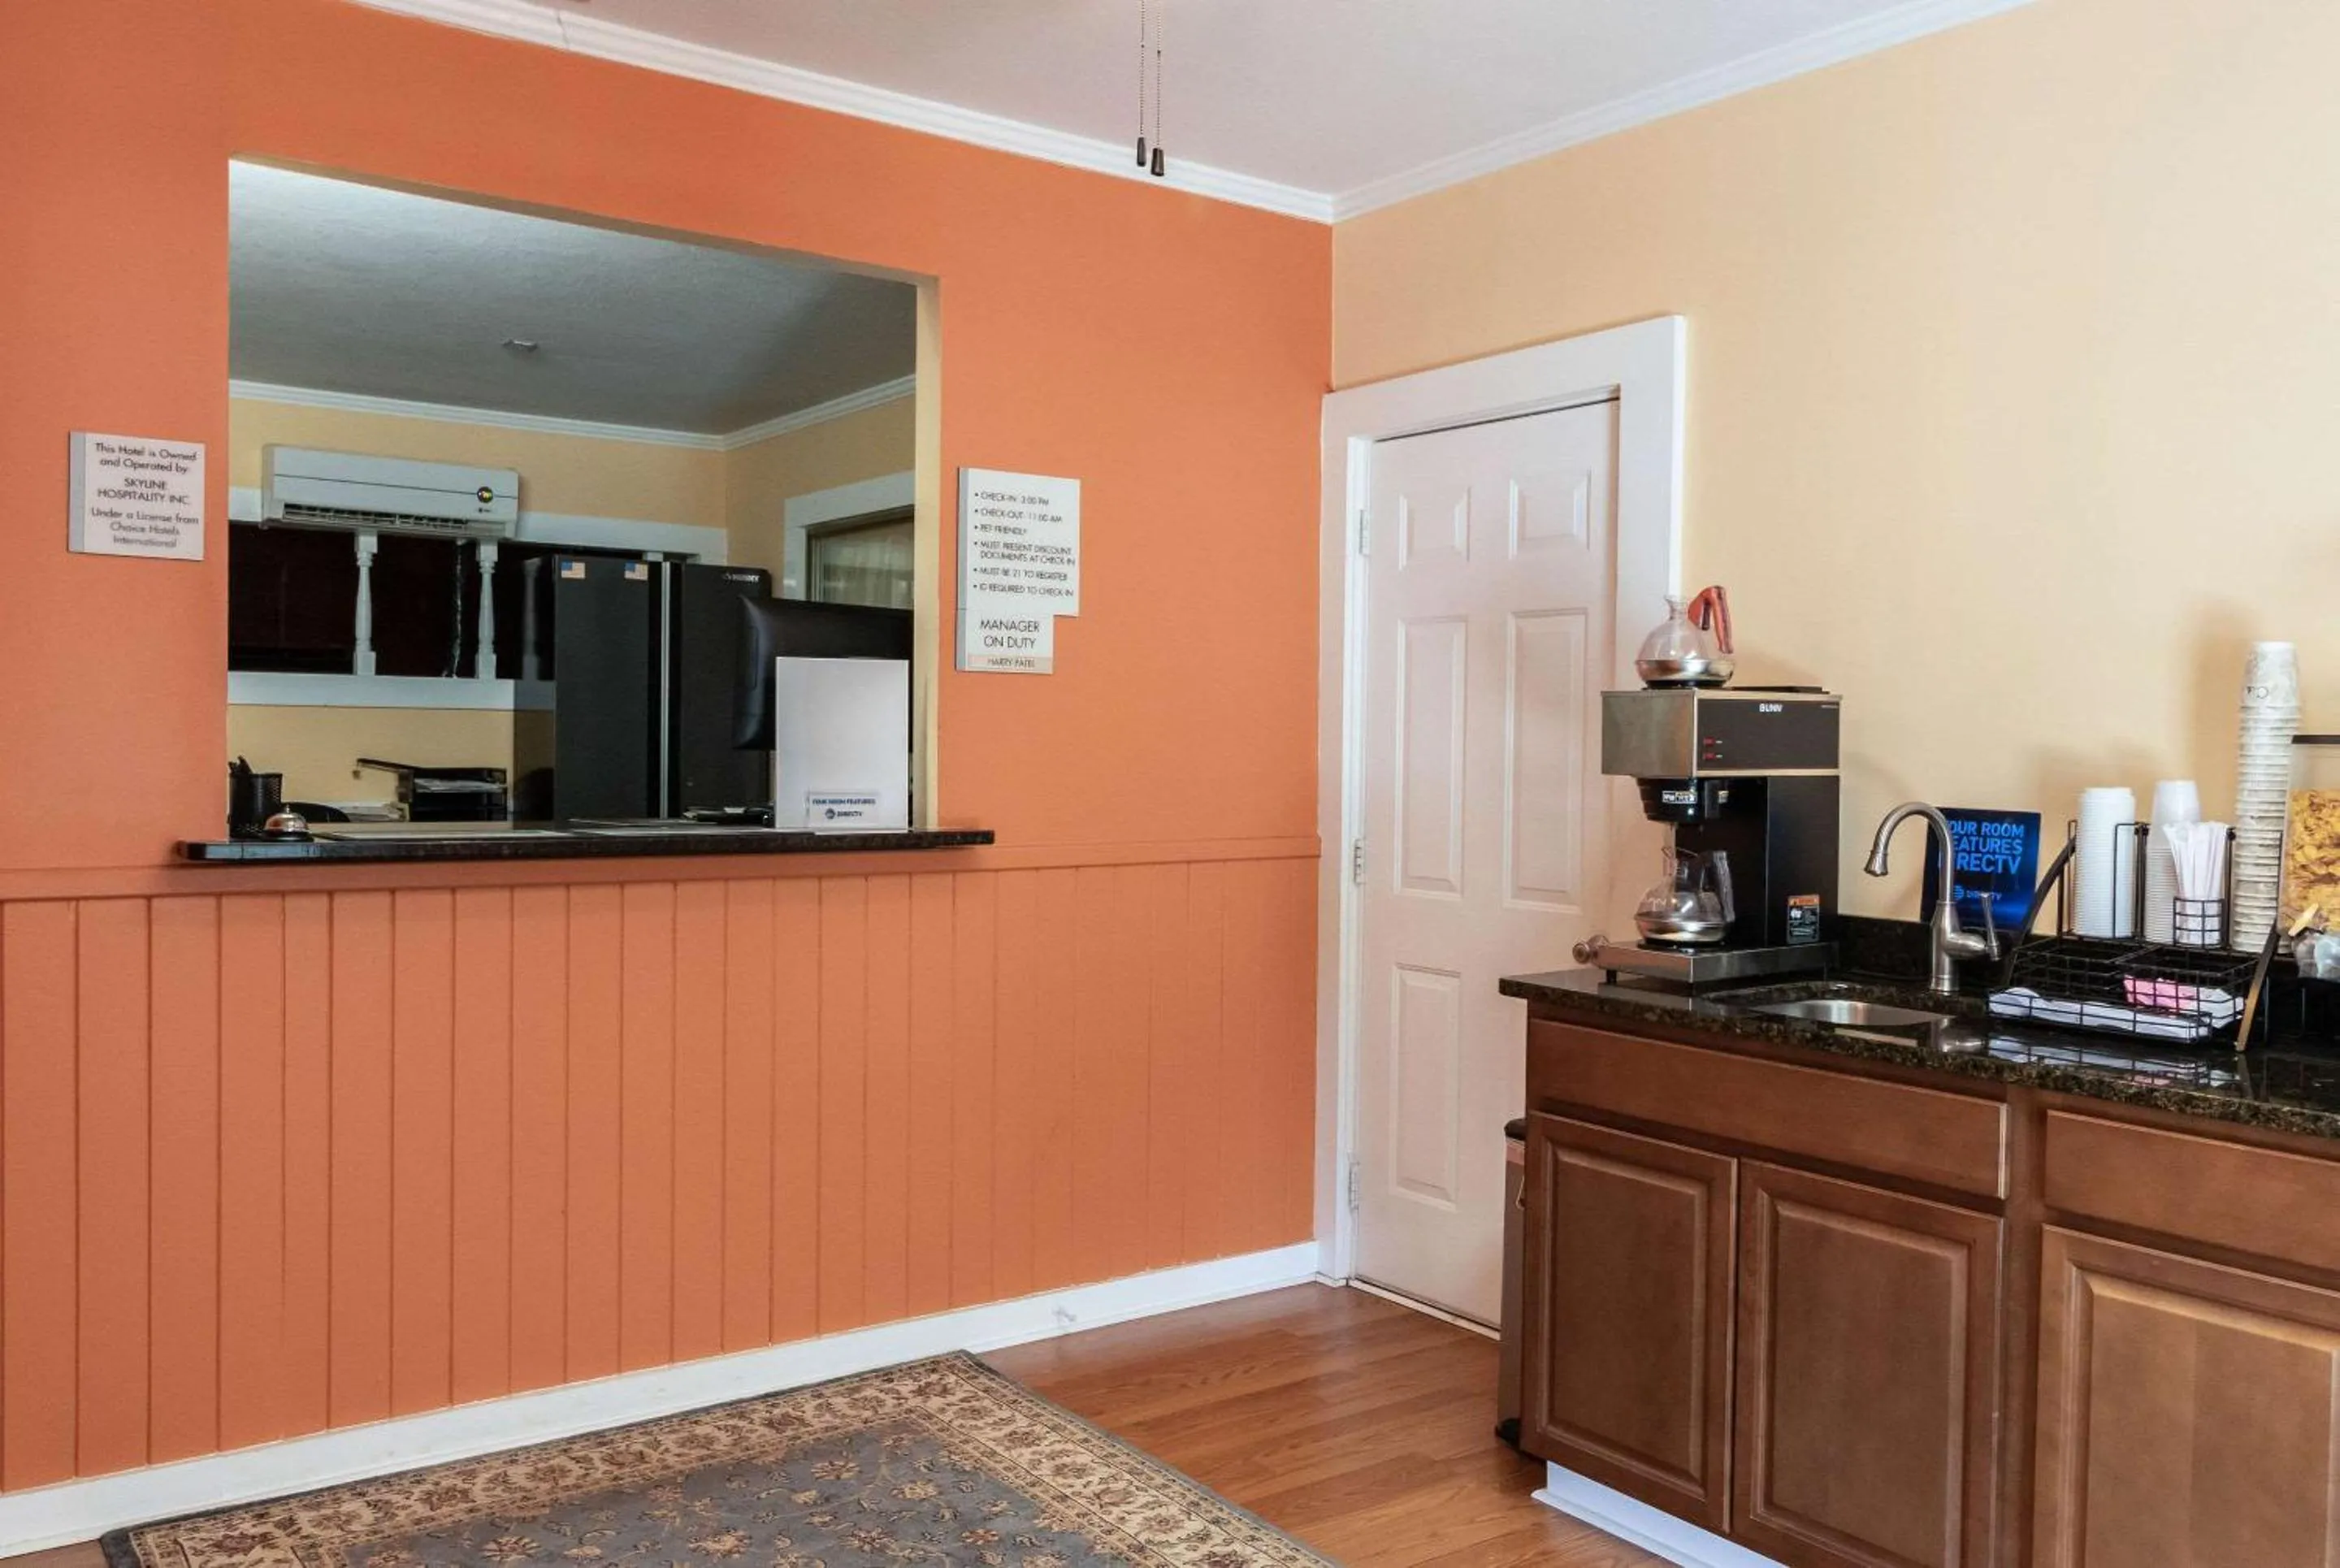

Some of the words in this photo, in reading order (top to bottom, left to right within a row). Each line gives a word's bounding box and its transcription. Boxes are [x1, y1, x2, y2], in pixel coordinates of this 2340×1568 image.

[95, 443, 115, 453] This
[119, 446, 145, 456] Hotel
[149, 449, 157, 457] is
[159, 449, 197, 461] Owned
[100, 458, 120, 467] and
[123, 458, 172, 472] Operated
[124, 478, 167, 490] SKYLINE
[98, 489, 165, 502] HOSPITALITY
[91, 508, 123, 518] Under
[136, 510, 172, 522] License
[176, 513, 199, 524] from
[110, 522, 145, 532] Choice
[150, 526, 180, 535] Hotels
[113, 535, 177, 548] International
[981, 541, 1000, 549] MUST
[1003, 542, 1033, 552] PRESENT
[1034, 545, 1072, 555] DISCOUNT
[980, 550, 1028, 561] DOCUMENTS
[980, 567, 999, 575] MUST
[1023, 570, 1034, 578] TO
[1036, 571, 1068, 581] REGISTER
[988, 583, 1025, 593] REQUIRED
[1027, 586, 1038, 594] TO
[981, 619, 1040, 633] MANAGER
[984, 635, 1004, 648] ON
[1008, 636, 1036, 649] DUTY
[1759, 703, 1783, 713] BUNN
[1947, 820, 1977, 834] OUR
[1981, 822, 2025, 838] ROOM
[1953, 835, 2023, 855] EATURES
[1956, 852, 2022, 874] RECTV
